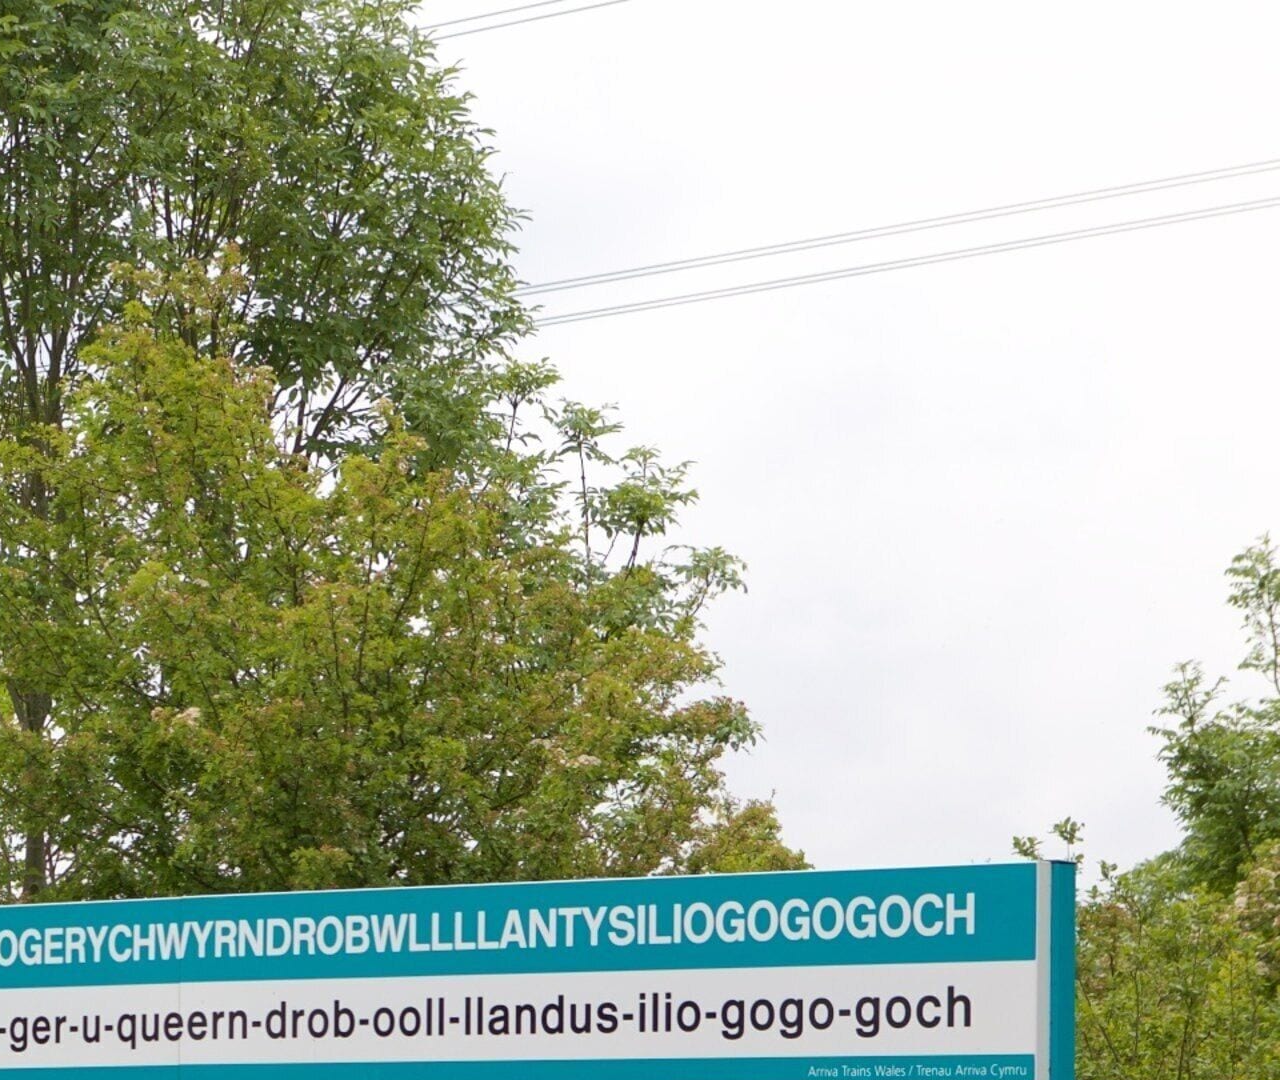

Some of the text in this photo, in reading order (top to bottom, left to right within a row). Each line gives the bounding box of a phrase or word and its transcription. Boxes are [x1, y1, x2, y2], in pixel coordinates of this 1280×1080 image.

[808, 1065, 838, 1077] Arriva
[842, 1065, 871, 1077] Trains
[874, 1065, 906, 1077] Wales
[917, 1064, 952, 1076] Trenau
[955, 1064, 987, 1076] Arriva
[990, 1063, 1027, 1078] Cymru
